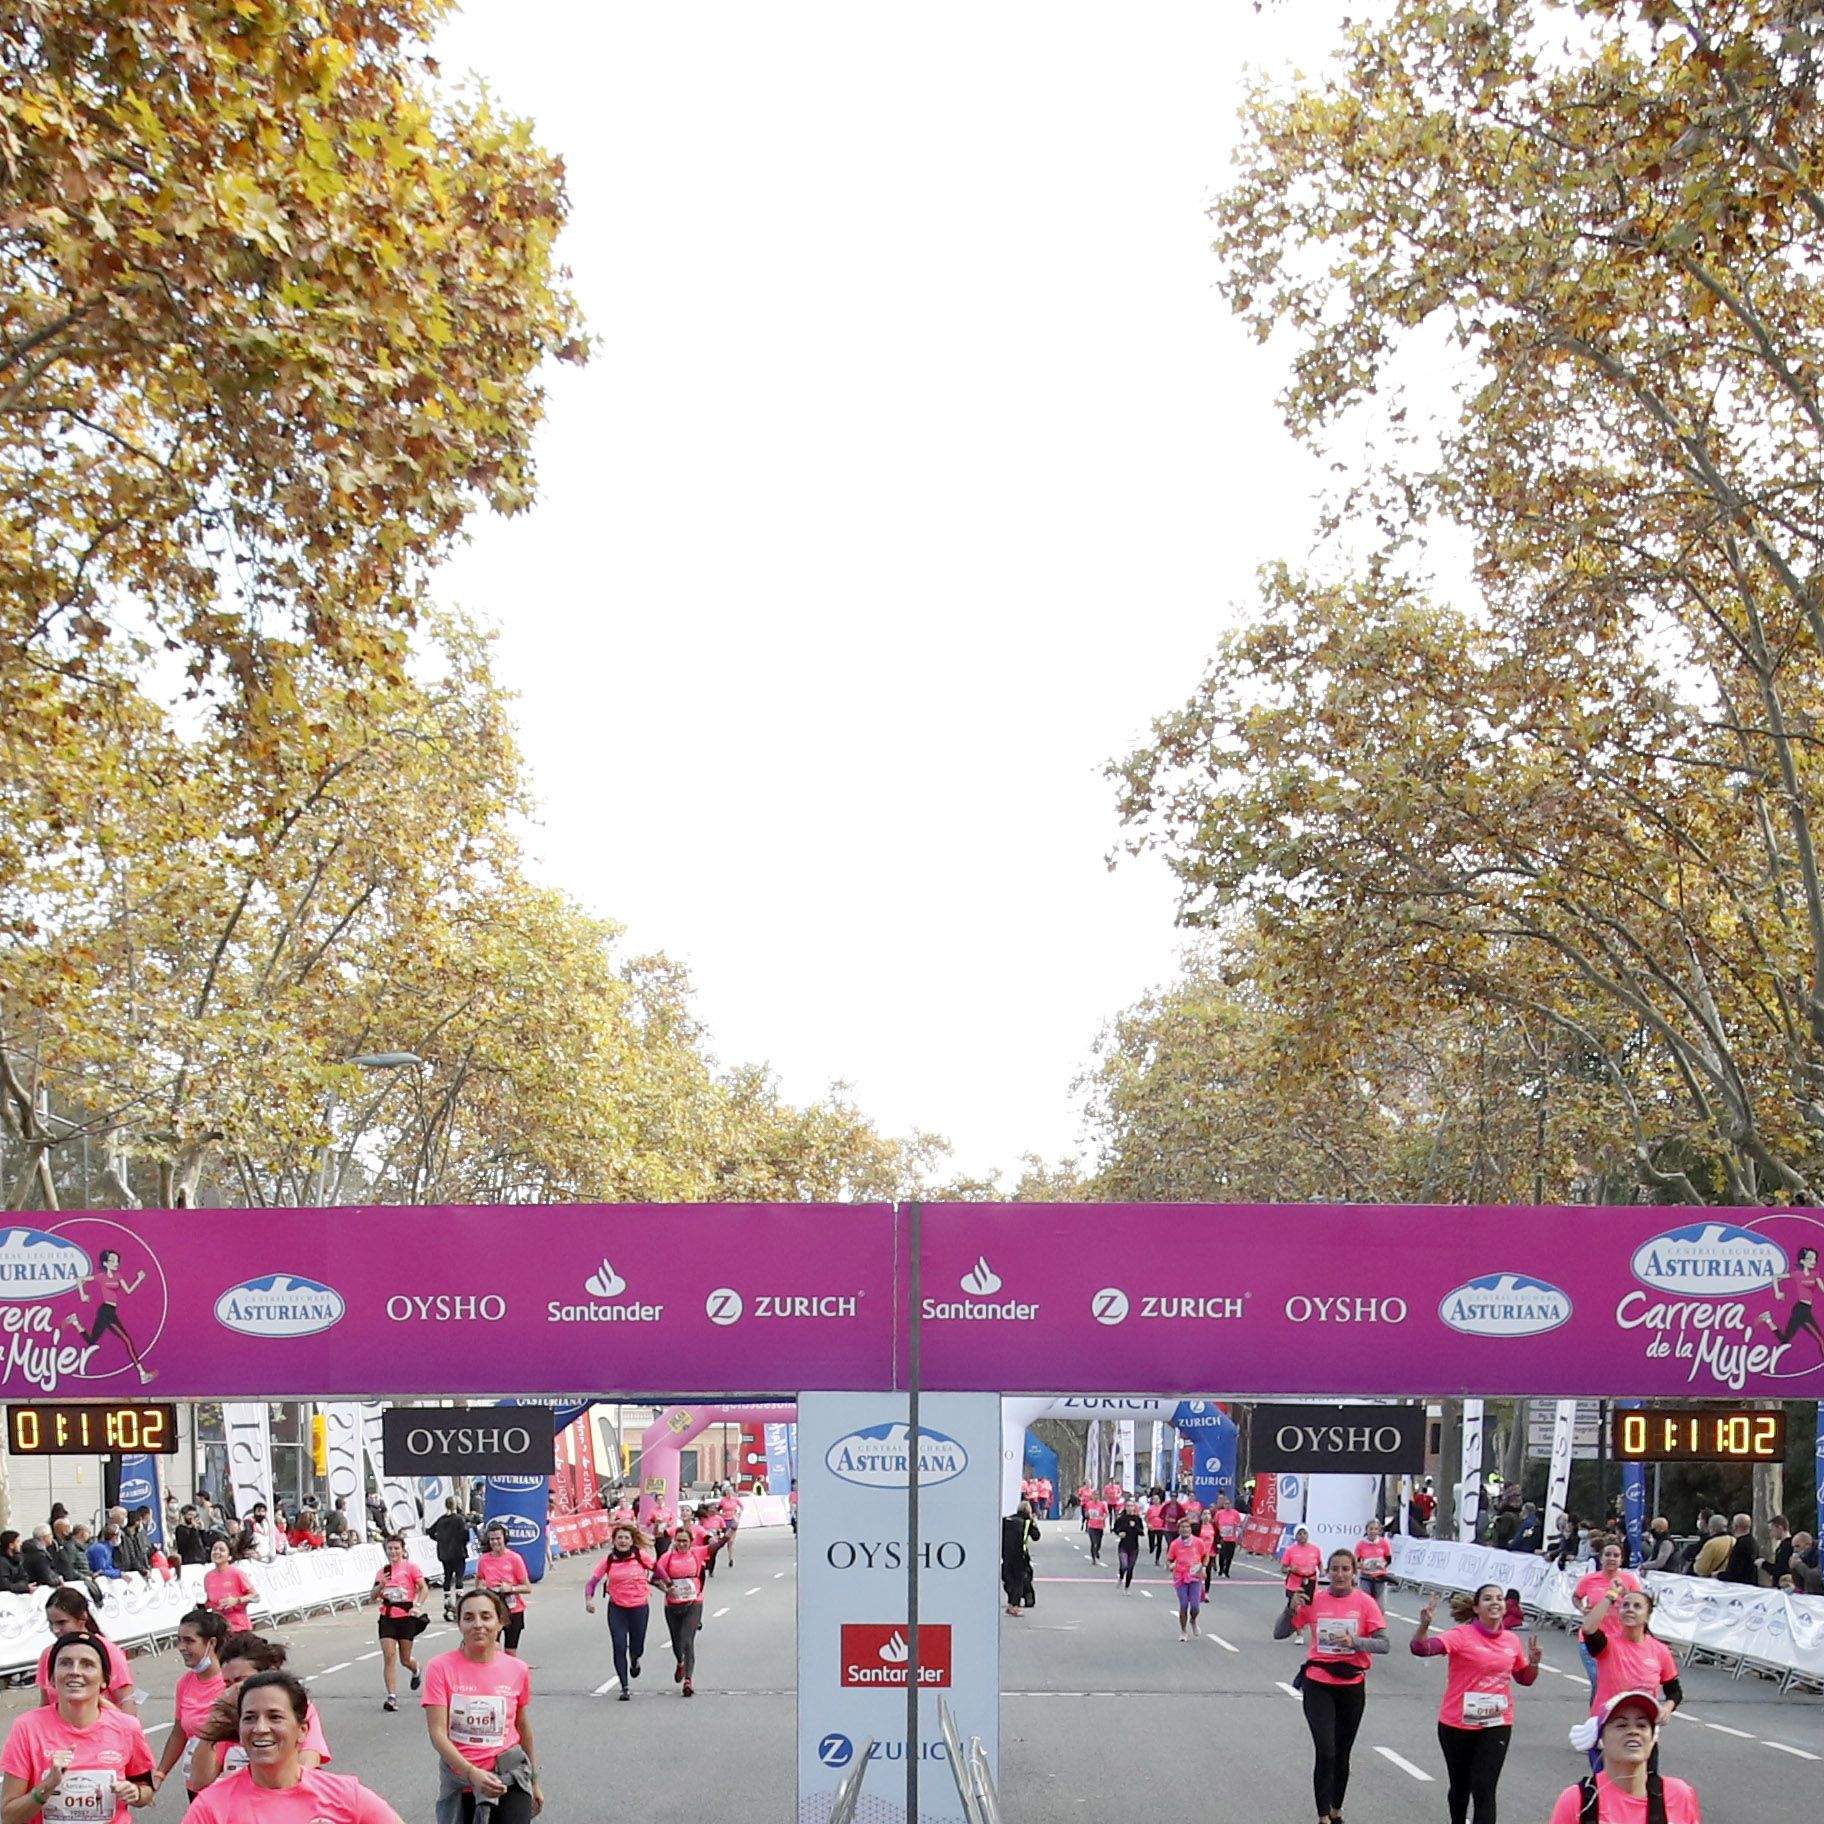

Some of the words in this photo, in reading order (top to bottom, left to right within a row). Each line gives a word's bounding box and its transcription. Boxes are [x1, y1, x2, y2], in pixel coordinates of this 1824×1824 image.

[1643, 1251, 1775, 1277] ASTURIANA
[225, 1297, 334, 1322] ASTURIANA
[385, 1294, 507, 1321] OYSHO
[547, 1302, 664, 1322] Santander
[754, 1296, 856, 1317] ZURICH
[922, 1299, 1039, 1321] Santander
[1140, 1297, 1243, 1318] ZURICH
[1284, 1295, 1408, 1323] OYSHO
[1449, 1298, 1561, 1321] ASTURIANA
[1616, 1291, 1746, 1329] Carrera
[2, 1329, 100, 1392] Mujer
[1646, 1332, 1671, 1358] de
[1675, 1332, 1693, 1358] la
[1688, 1326, 1791, 1390] Mujer
[1178, 1416, 1221, 1428] ZURICH
[406, 1427, 531, 1456] OYSHO
[1276, 1425, 1402, 1453] OYSHO
[837, 1447, 957, 1472] ASTURANA
[1195, 1476, 1232, 1486] ZURICH
[1317, 1523, 1362, 1535] OYSHO
[827, 1541, 966, 1569] OYSHO
[848, 1665, 944, 1682] Santander
[467, 1716, 490, 1726] 016
[869, 1742, 964, 1760] ZUIC
[64, 1796, 95, 1808] 016
